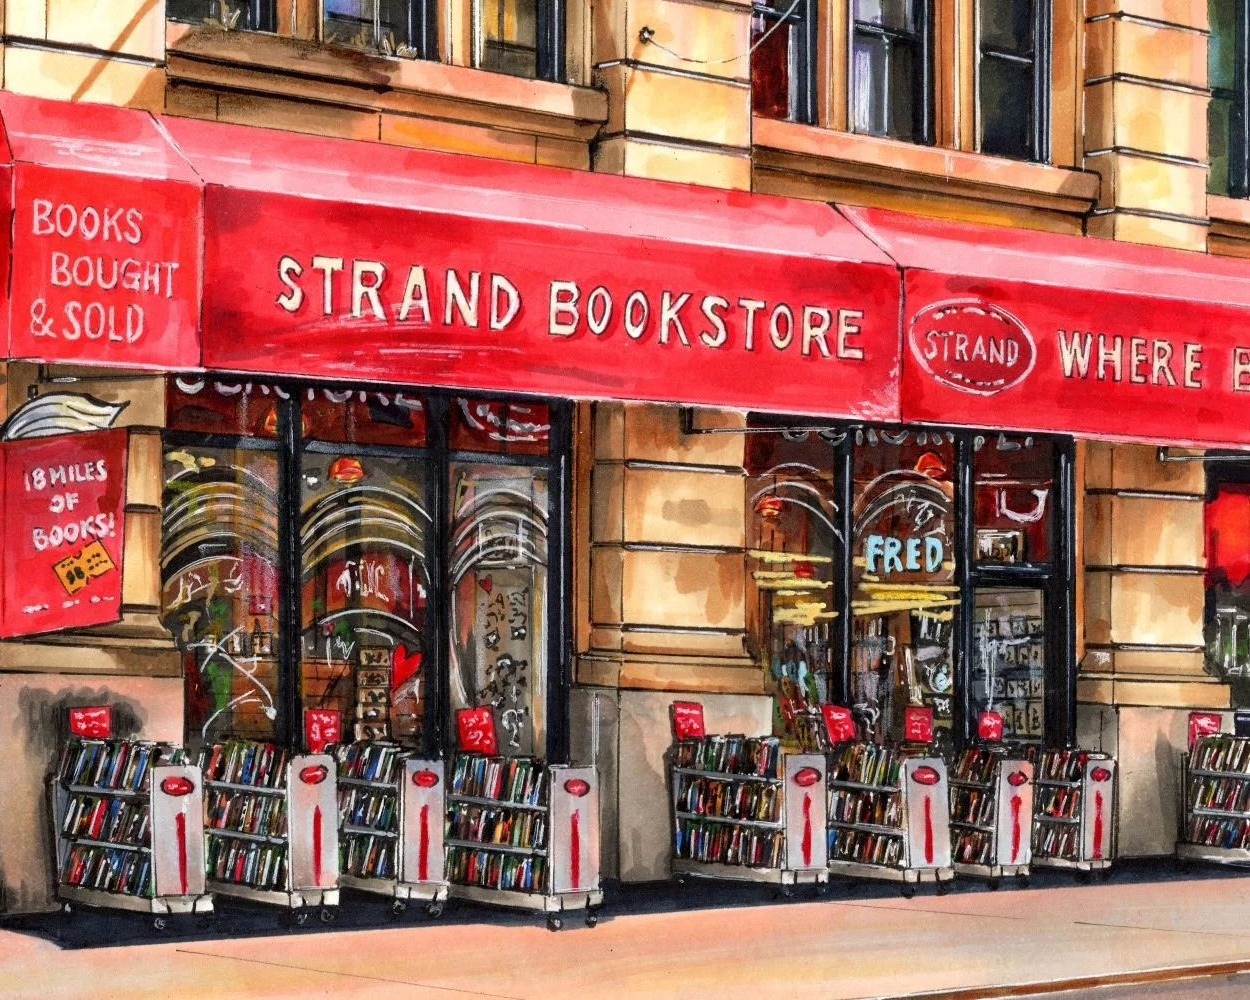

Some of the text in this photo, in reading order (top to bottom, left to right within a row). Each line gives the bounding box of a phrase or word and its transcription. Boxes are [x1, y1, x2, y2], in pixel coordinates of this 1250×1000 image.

[32, 198, 144, 244] BOOKS
[51, 251, 180, 297] BOUGHT
[29, 298, 145, 343] & SOLD
[276, 255, 865, 360] STRAND BOOKSTORE
[923, 330, 1019, 368] STRAND
[1056, 328, 1203, 389] WHERE
[23, 459, 108, 491] 18 MILES
[49, 492, 79, 513] OF
[32, 512, 116, 551] BOOKS!
[865, 534, 945, 574] FRED
